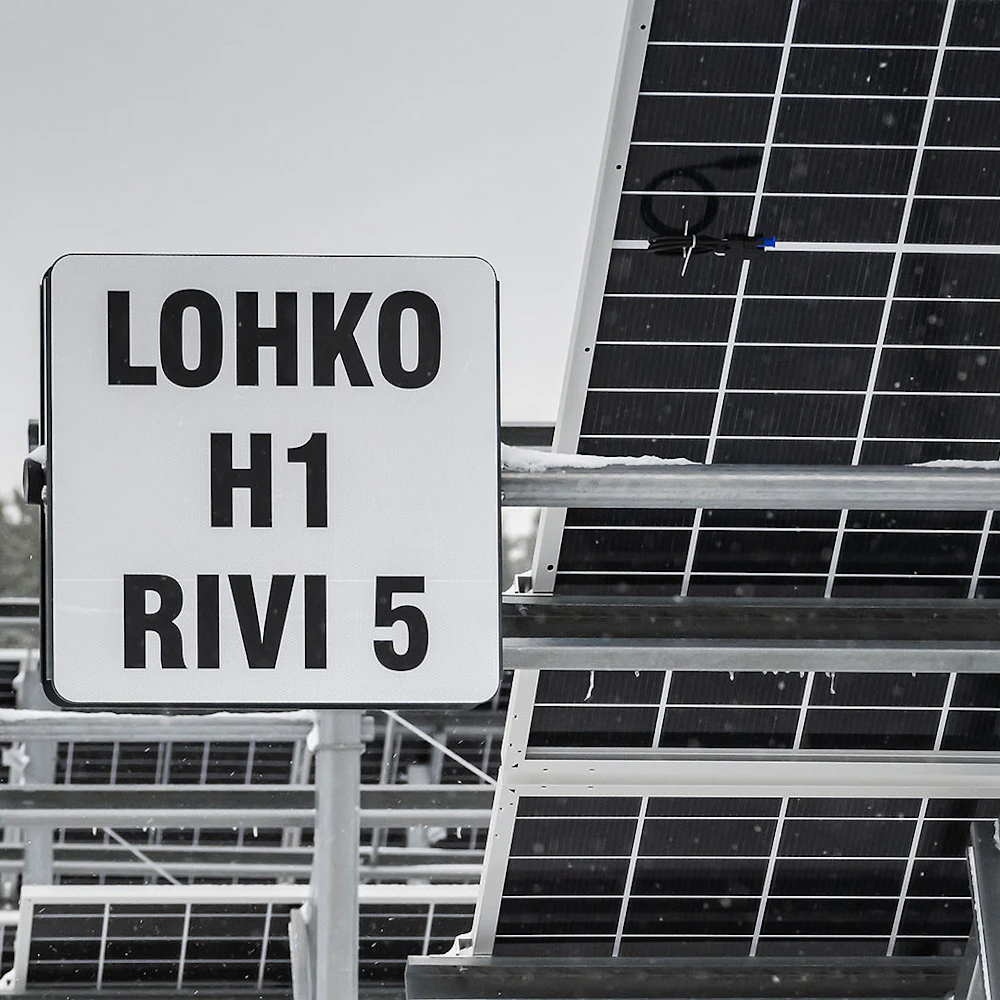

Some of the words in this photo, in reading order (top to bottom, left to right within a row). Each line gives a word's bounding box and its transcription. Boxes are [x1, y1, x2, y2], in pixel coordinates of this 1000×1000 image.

[107, 288, 441, 390] LOHKO
[210, 432, 328, 528] H1
[123, 573, 327, 670] RIVI
[373, 575, 429, 672] 5
